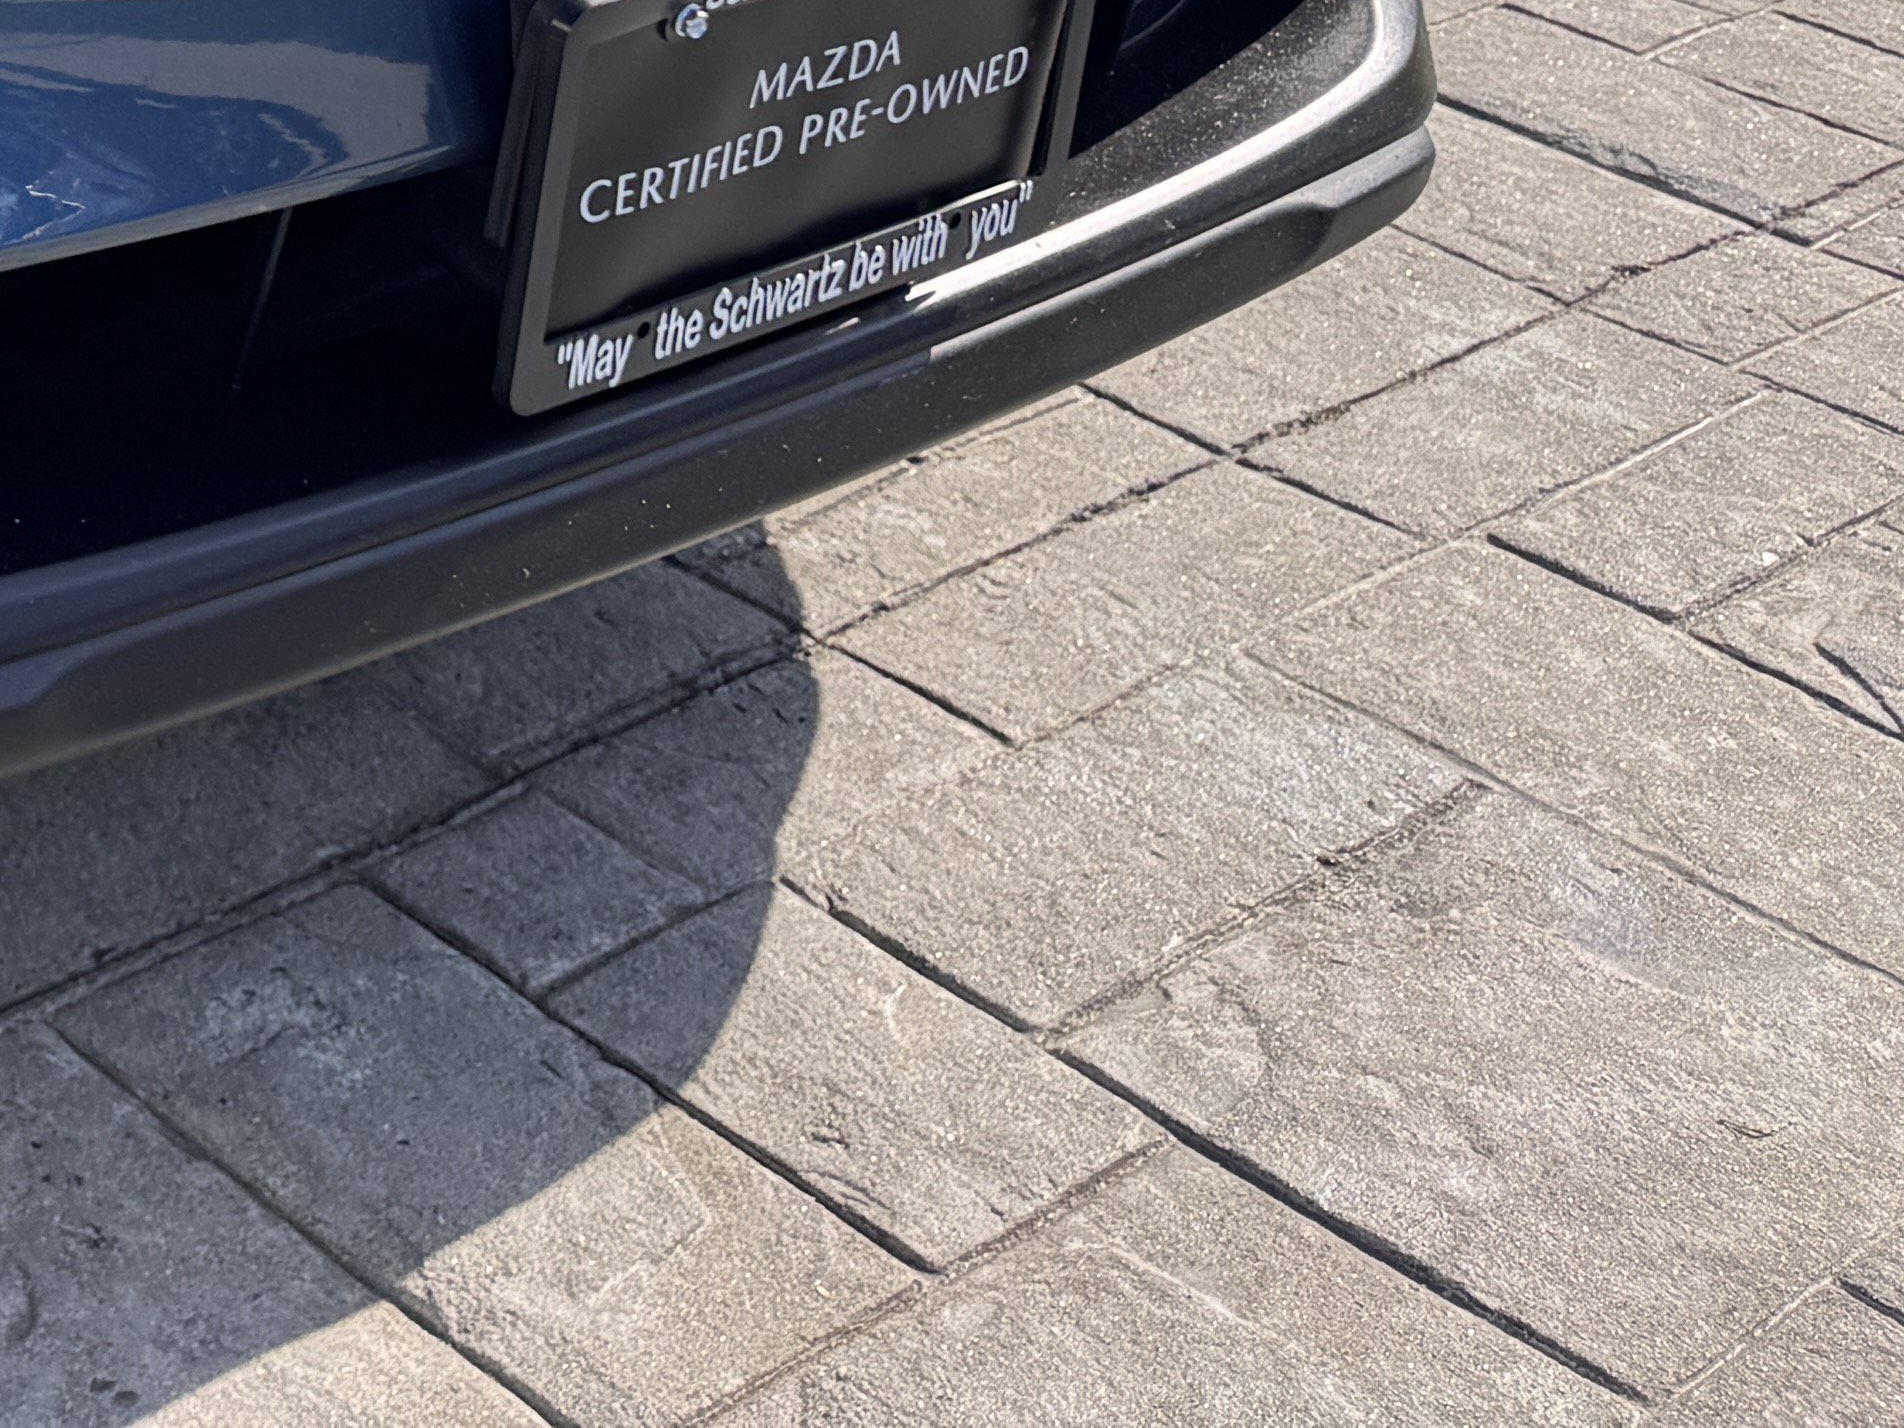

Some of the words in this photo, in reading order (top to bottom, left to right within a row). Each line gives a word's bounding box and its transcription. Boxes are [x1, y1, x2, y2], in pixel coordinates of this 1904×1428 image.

[580, 125, 783, 223] CERTIFIED
[800, 46, 1028, 154] PRE-OWNED
[750, 31, 901, 109] MAZDA
[557, 334, 633, 389] "May
[655, 307, 703, 359] the
[709, 253, 846, 340] Schwartz
[848, 241, 884, 293] be
[892, 213, 948, 275] with
[966, 180, 1034, 259] you"
